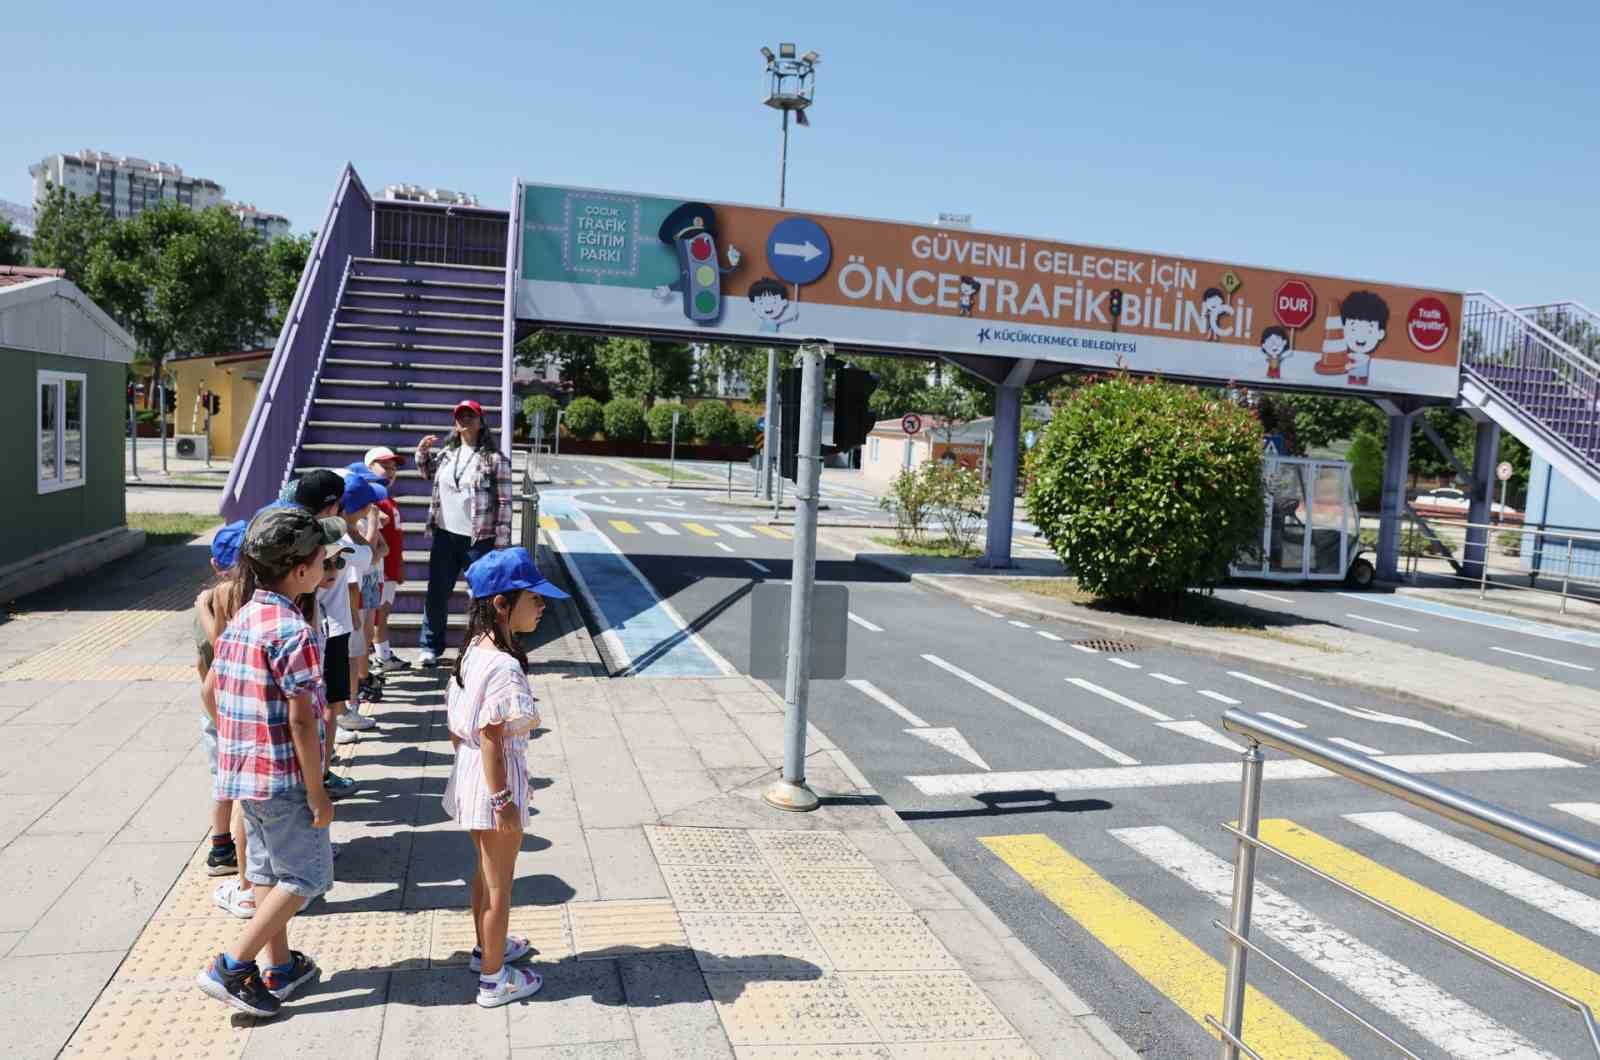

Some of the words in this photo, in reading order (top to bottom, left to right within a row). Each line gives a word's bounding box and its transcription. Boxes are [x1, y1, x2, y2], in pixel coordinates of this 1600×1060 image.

[577, 216, 626, 232] TRAFİK
[577, 231, 625, 247] EĞİTİM
[580, 248, 621, 262] PARKI
[911, 232, 1026, 270] GÜVENLİ
[1033, 249, 1145, 283] GELECEK
[1151, 259, 1198, 292] İÇİN
[838, 254, 961, 308] ÖNCE
[972, 275, 1112, 324] TRAFİK
[1121, 288, 1254, 338] BİLİNCİ!
[1279, 295, 1308, 312] DUR
[993, 328, 1079, 347] KÜÇÜKÇEKMECE
[1081, 338, 1137, 353] BELEDİYESİ
